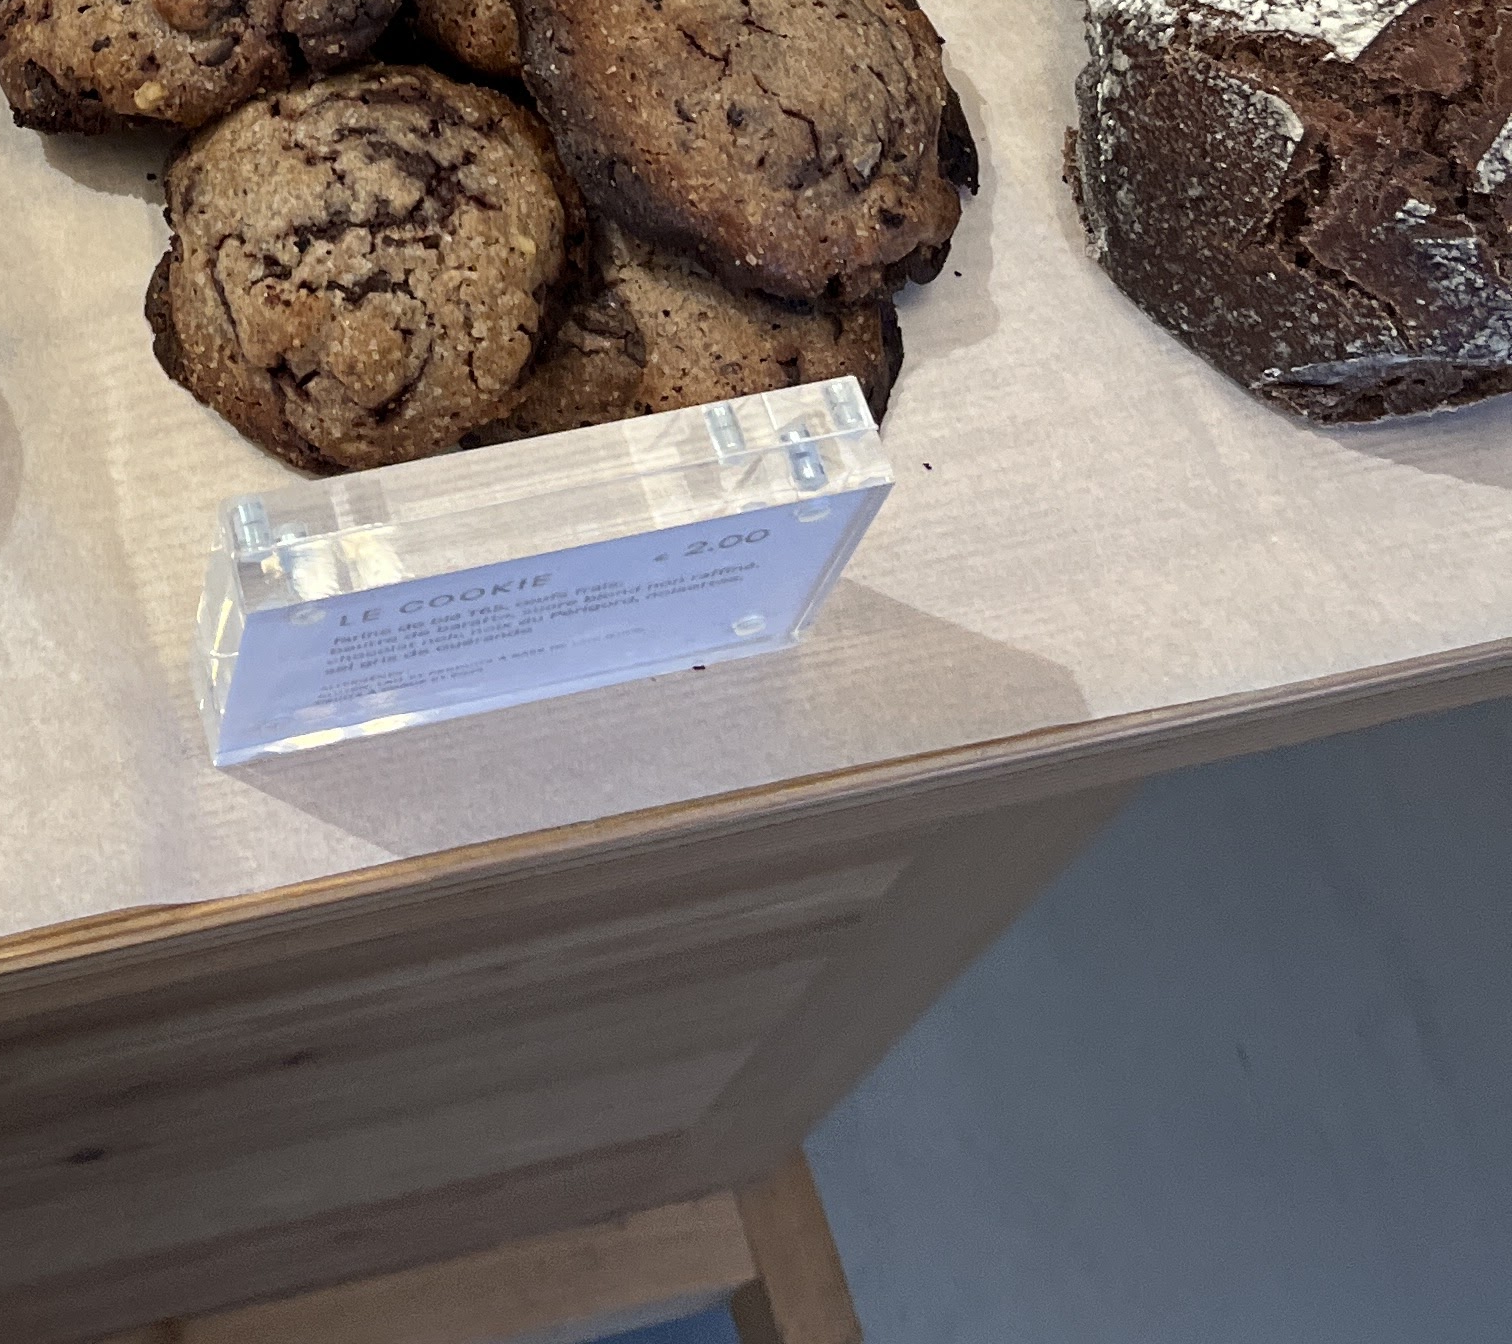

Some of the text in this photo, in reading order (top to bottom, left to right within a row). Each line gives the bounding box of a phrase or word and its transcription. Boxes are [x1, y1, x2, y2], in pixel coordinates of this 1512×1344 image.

[339, 607, 381, 628] LE
[399, 572, 552, 614] COOKIE
[684, 528, 771, 557] 2.00
